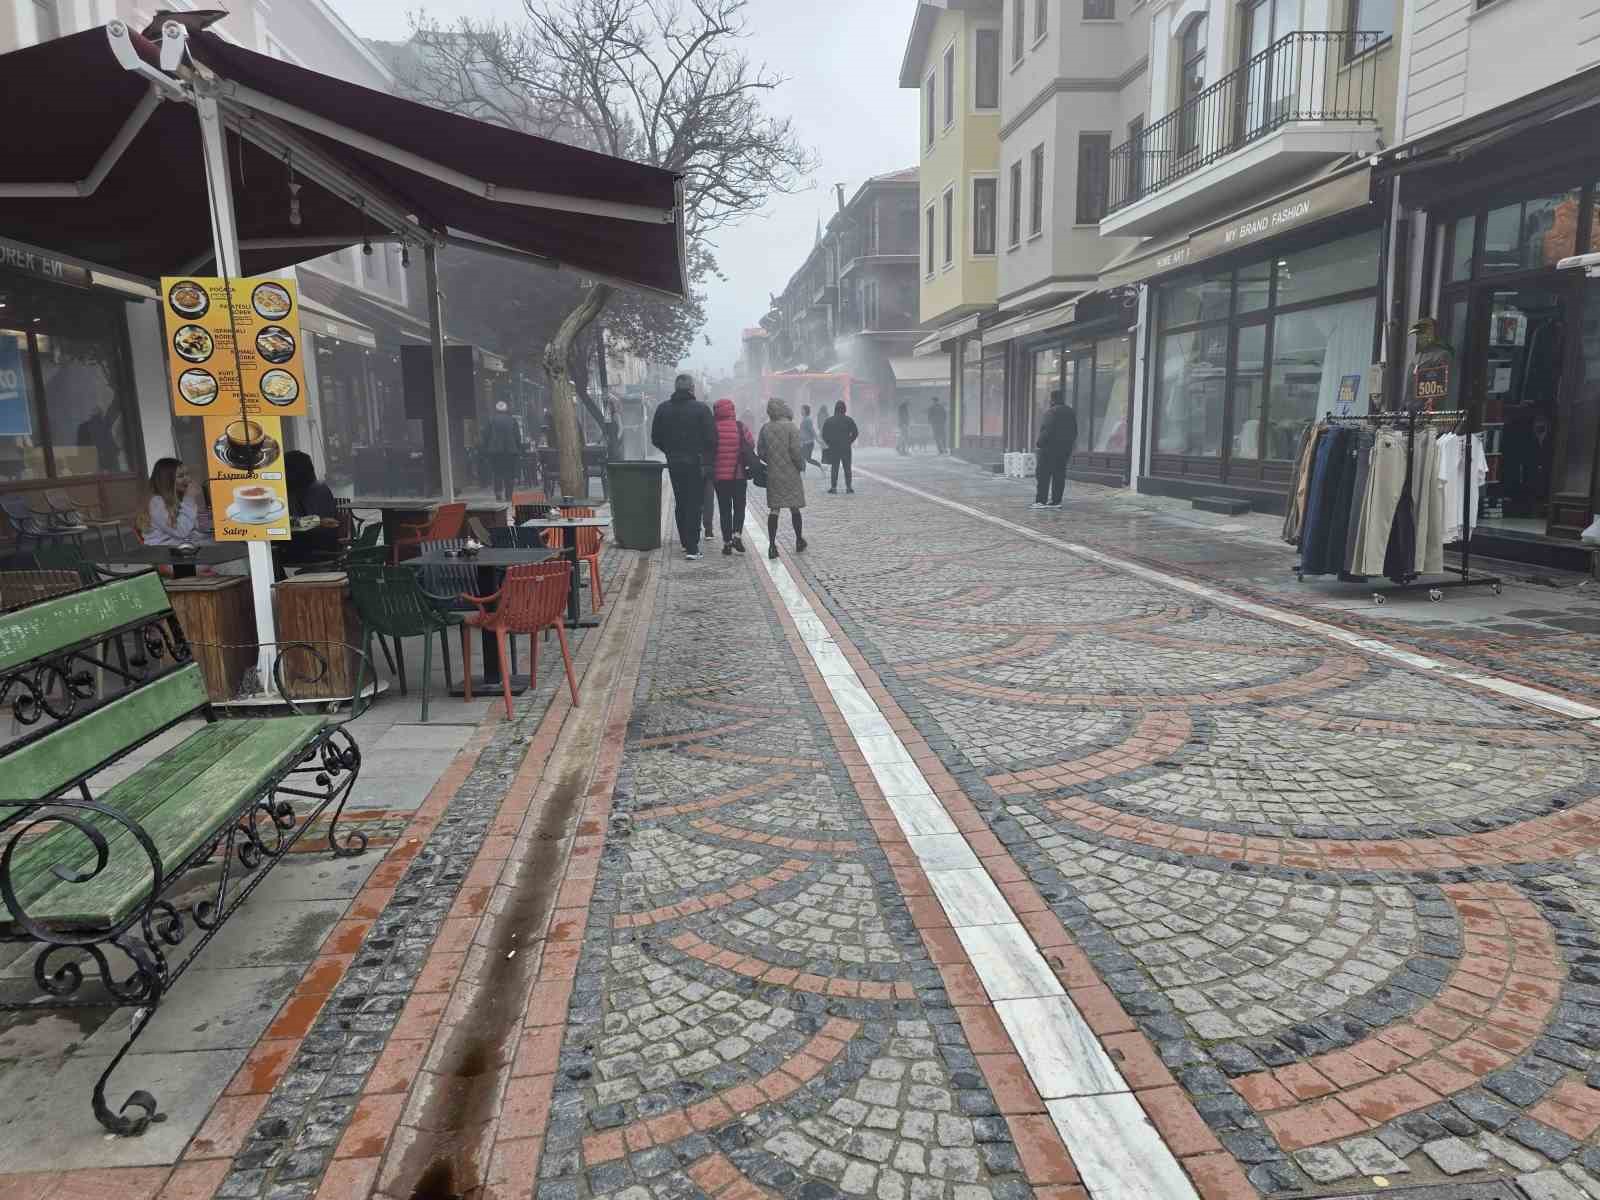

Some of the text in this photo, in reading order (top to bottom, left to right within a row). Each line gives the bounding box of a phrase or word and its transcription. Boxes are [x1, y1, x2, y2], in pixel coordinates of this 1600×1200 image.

[1225, 200, 1311, 243] MY BRAND FASHION
[223, 527, 248, 537] Salep
